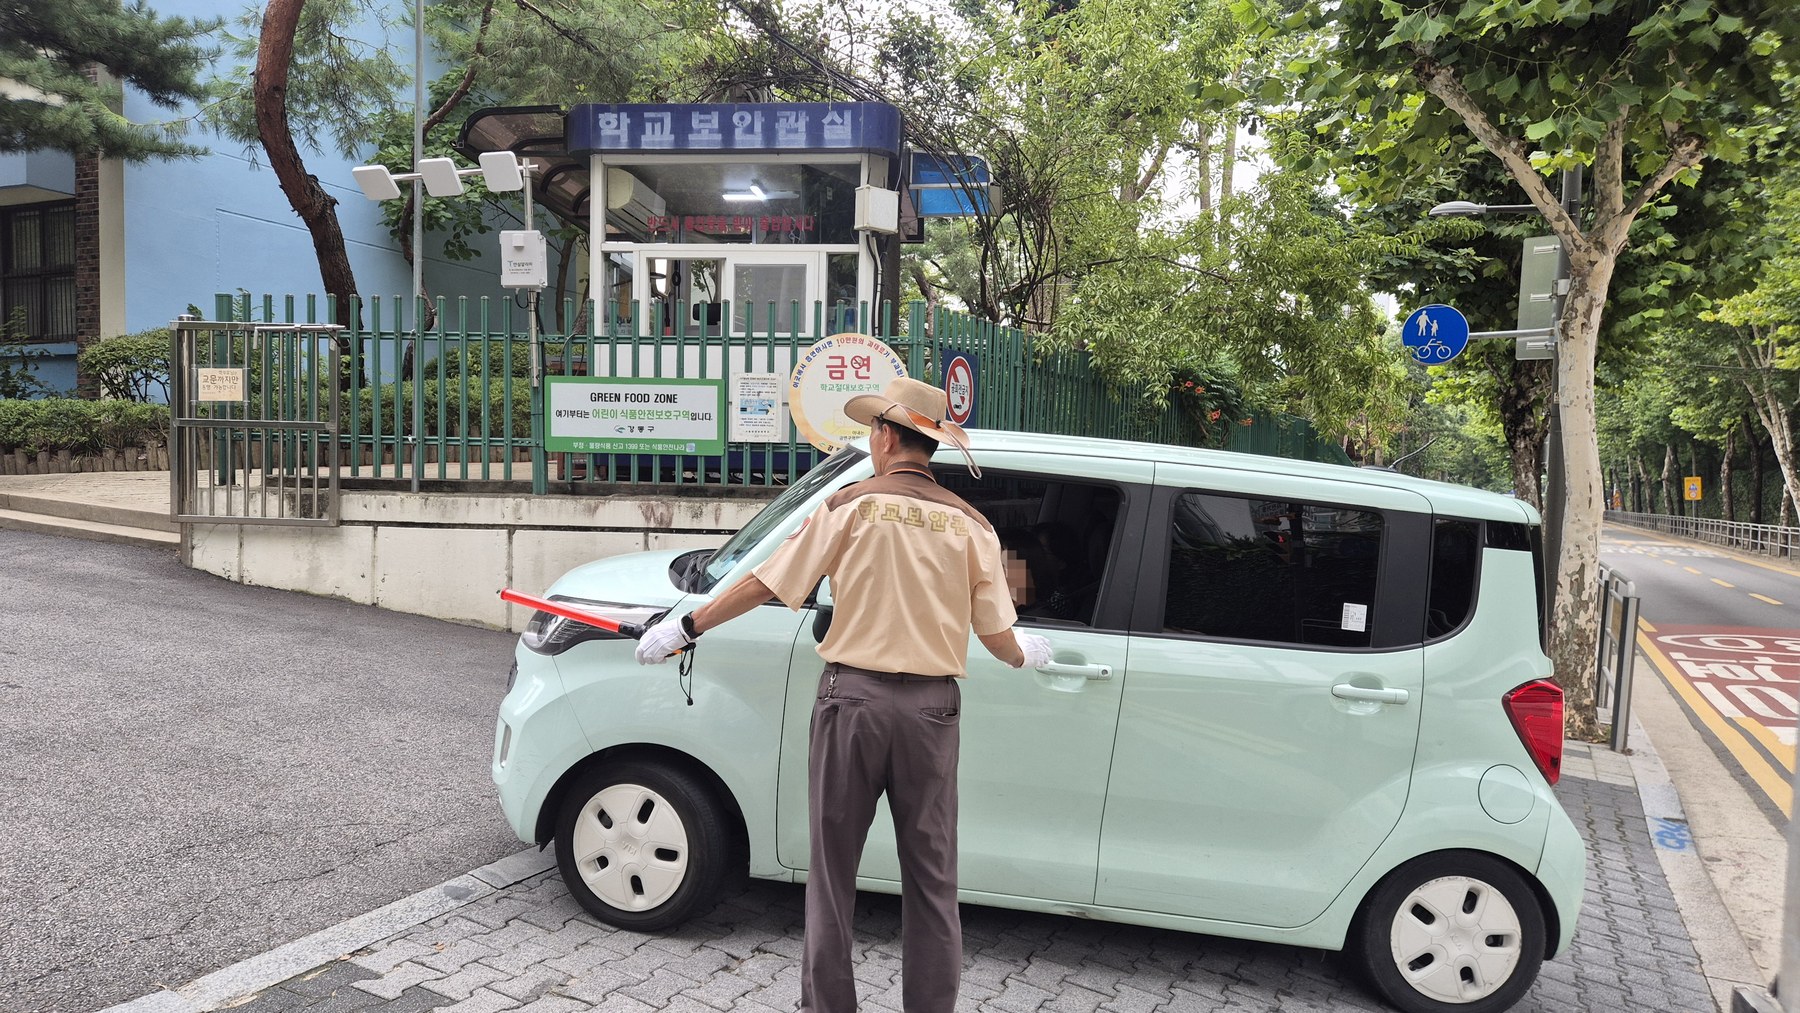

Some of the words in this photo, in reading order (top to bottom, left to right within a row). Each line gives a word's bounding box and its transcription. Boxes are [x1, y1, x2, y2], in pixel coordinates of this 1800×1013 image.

[598, 109, 852, 142] 학교보안관실
[826, 355, 871, 380] 금연
[890, 357, 905, 378] 부과됩
[203, 374, 239, 384] 교문까지만
[820, 383, 880, 392] 학교절대보호구역
[590, 392, 621, 403] GREEN
[624, 393, 650, 404] FOOD
[654, 393, 678, 404] ZONE
[555, 409, 590, 419] 여기부터는
[591, 408, 618, 419] 어린이
[627, 425, 655, 433] 강동구
[612, 442, 624, 450] 신고
[858, 501, 970, 536] 학교보안관
